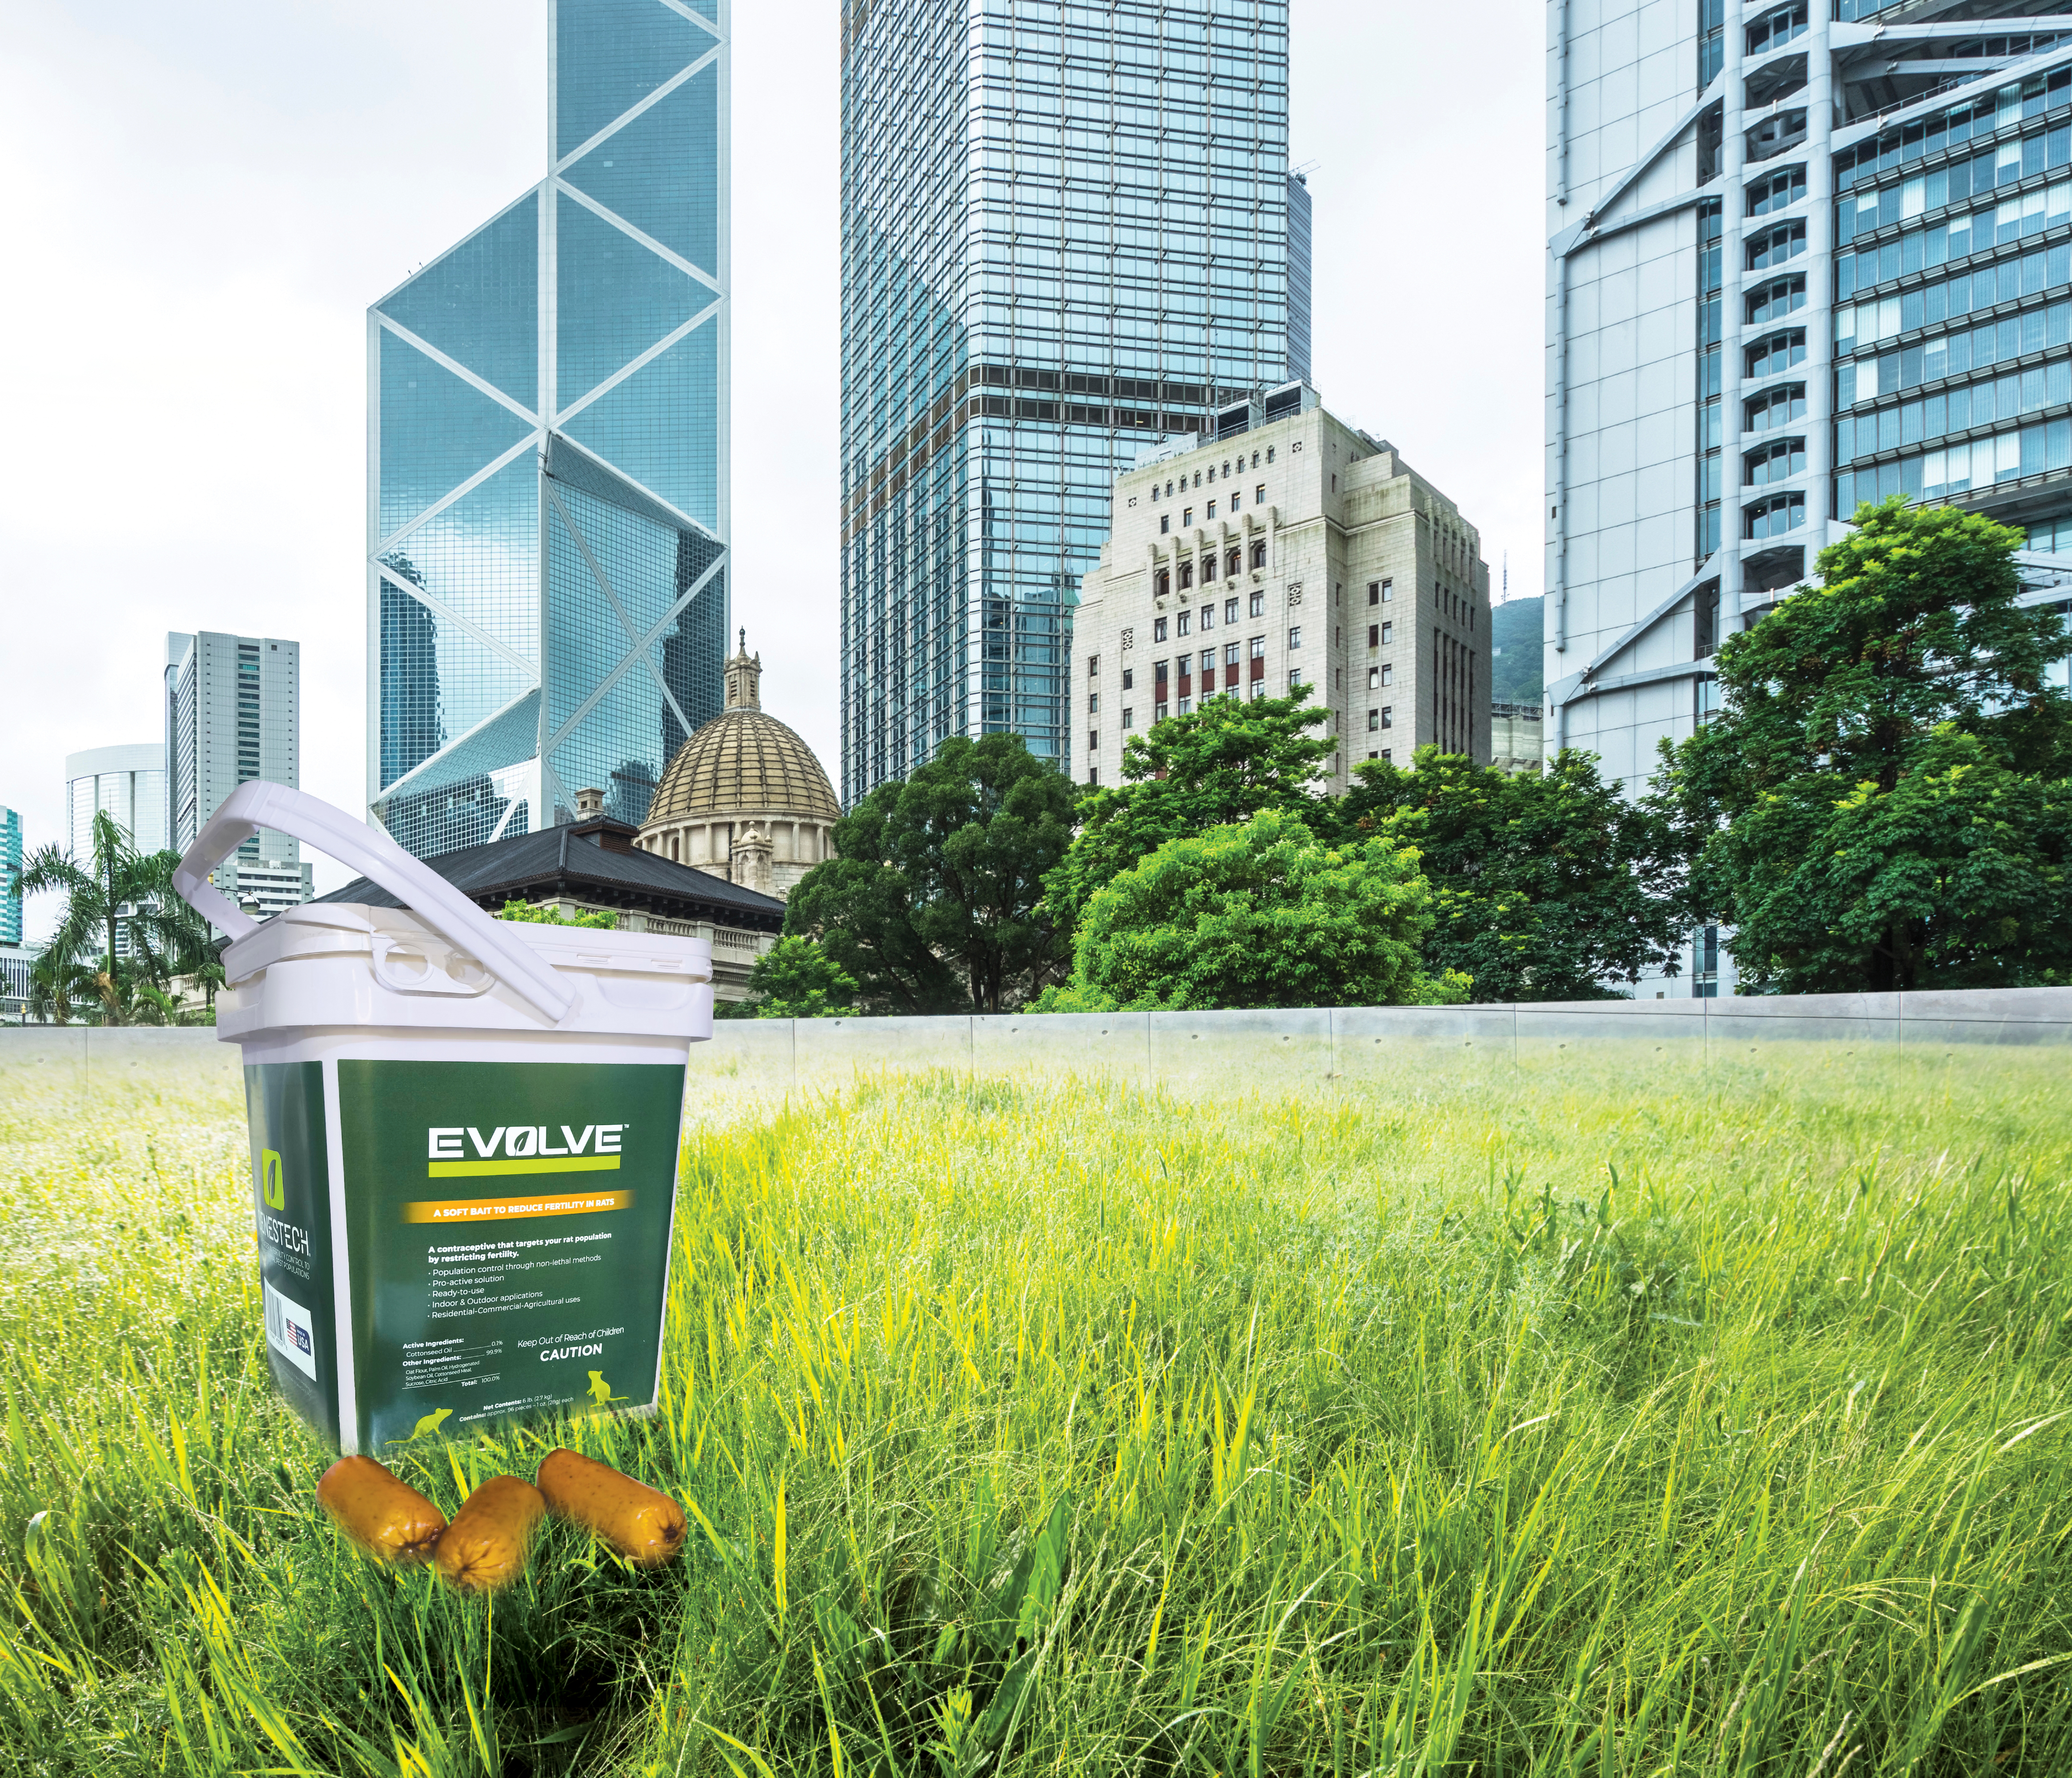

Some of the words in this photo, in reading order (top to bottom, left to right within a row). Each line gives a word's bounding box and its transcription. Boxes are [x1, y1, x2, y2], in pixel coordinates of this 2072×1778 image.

[443, 1208, 468, 1216] SOFT
[471, 1207, 492, 1215] BAIT
[508, 1204, 543, 1213] REDUCE
[545, 1201, 585, 1211] FERTILITY
[596, 1198, 615, 1207] RATS
[437, 1243, 495, 1253] contraceptive
[516, 1239, 543, 1248] targets
[545, 1238, 562, 1246] your
[575, 1232, 611, 1243] population
[272, 1246, 285, 1260] FERTILITY
[286, 1254, 303, 1268] CONTROL
[304, 1261, 310, 1270] TO
[441, 1252, 486, 1262] restricting
[487, 1250, 519, 1259] fertility.
[283, 1262, 310, 1280] POPULATIONS
[433, 1267, 475, 1277] Population
[478, 1264, 503, 1272] control
[506, 1261, 534, 1271] through
[536, 1258, 571, 1267] non-lethal
[573, 1255, 601, 1264] methods
[433, 1278, 472, 1287] Pro-active
[475, 1275, 504, 1284] solution
[432, 1288, 484, 1298] Ready-to-use
[467, 1296, 499, 1305] Outdoor
[500, 1291, 543, 1302] applications
[432, 1298, 563, 1318] Residential-Commercial-Agricultural
[297, 1334, 309, 1351] USA
[426, 1338, 464, 1347] Ingredients:
[518, 1339, 537, 1348] Keep
[564, 1332, 587, 1341] Reach
[588, 1330, 596, 1338] of
[597, 1327, 624, 1337] Children
[406, 1348, 442, 1357] Cottonseed
[540, 1343, 603, 1361] CAUTION
[423, 1355, 462, 1365] Ingredients:
[449, 1360, 480, 1370] Hydrogenated
[495, 1400, 522, 1408] Contents:
[459, 1413, 486, 1422] Contains:
